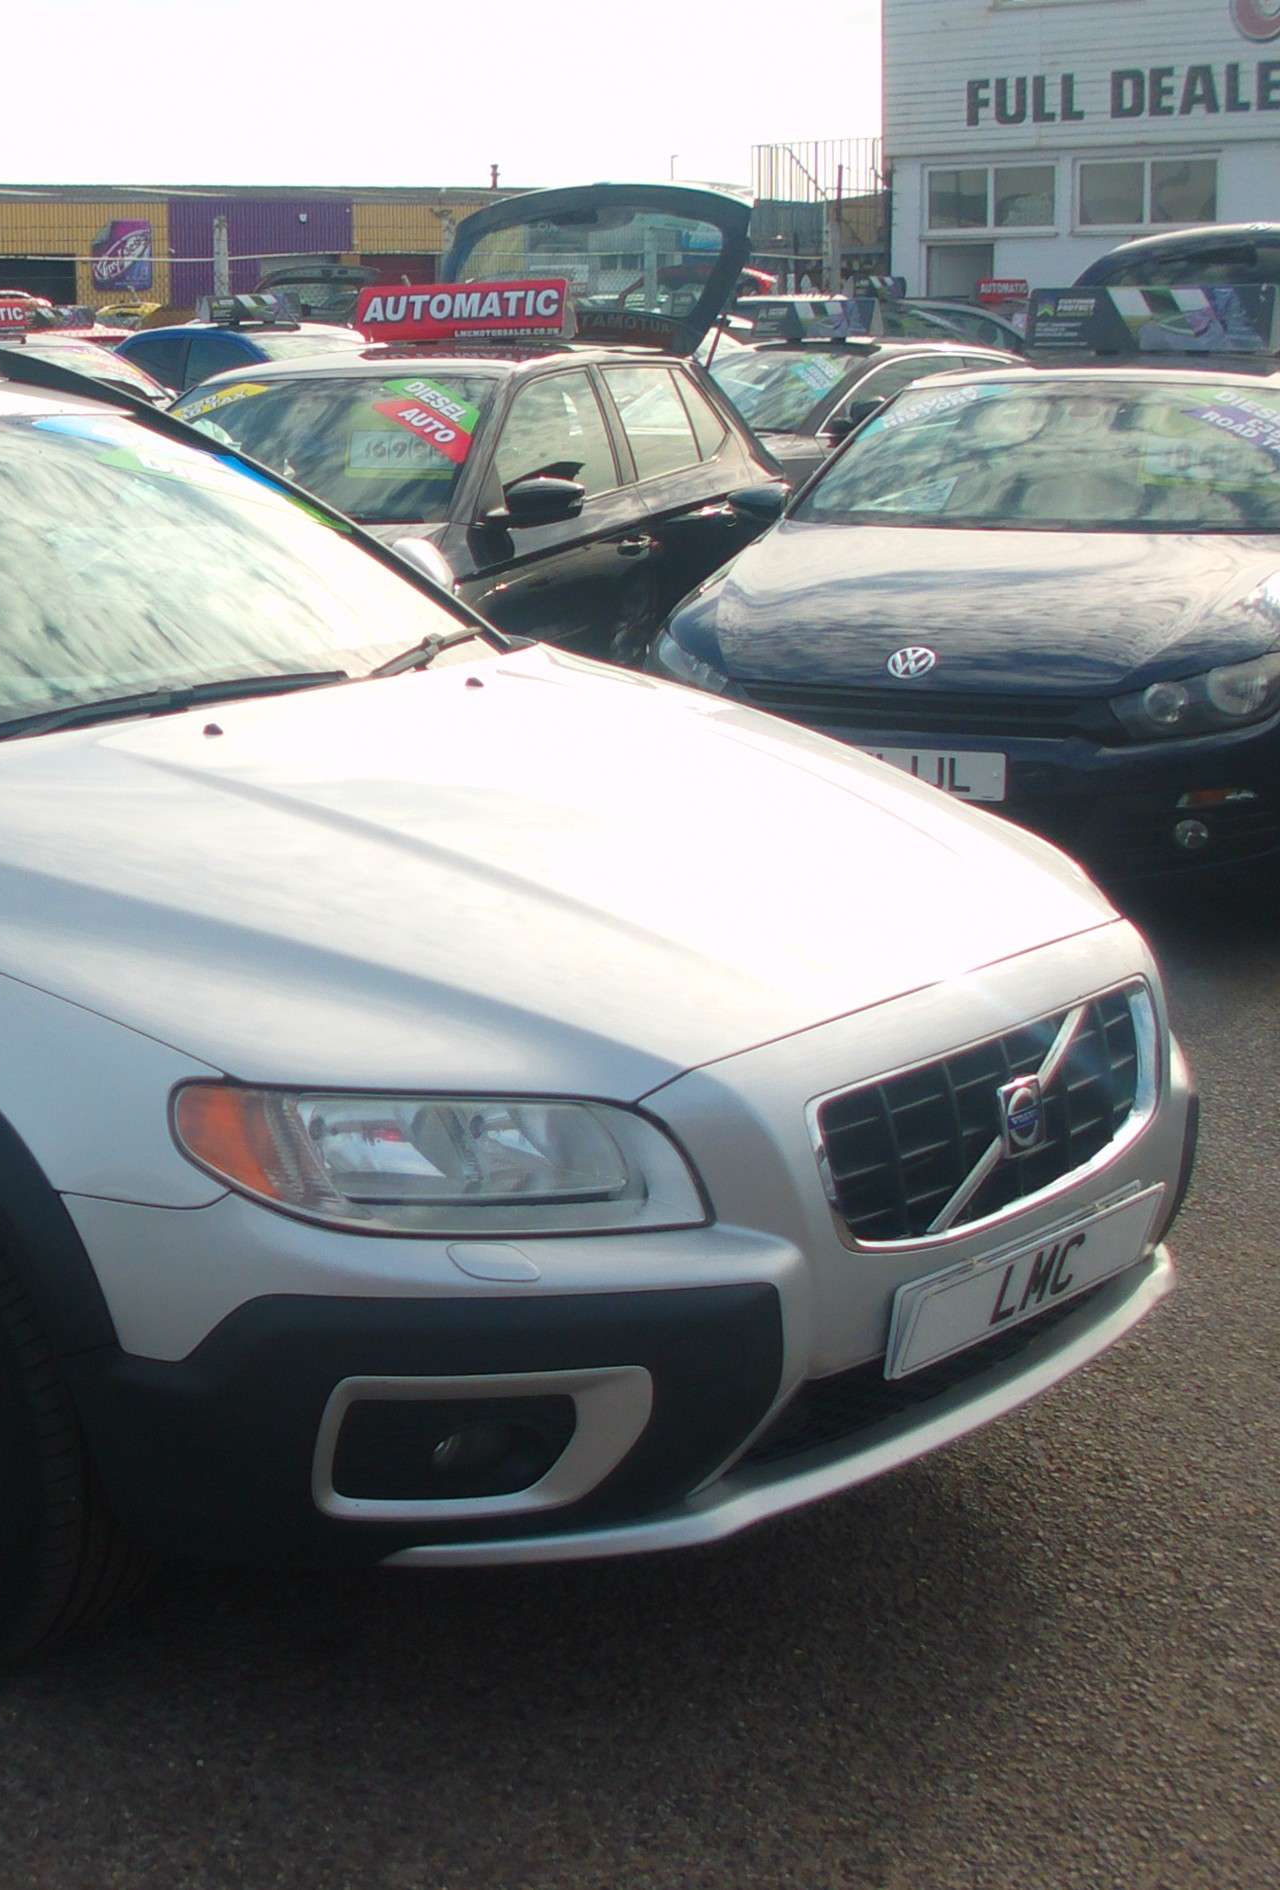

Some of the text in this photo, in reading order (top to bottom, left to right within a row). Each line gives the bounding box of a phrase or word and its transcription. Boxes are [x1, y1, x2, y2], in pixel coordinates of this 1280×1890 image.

[966, 73, 1085, 127] FULL
[363, 288, 560, 323] AUTOMATIC
[403, 381, 466, 422] DIESEL
[397, 408, 456, 442] AUTO
[1200, 411, 1259, 438] ROAD
[989, 1233, 1085, 1325] LMC
